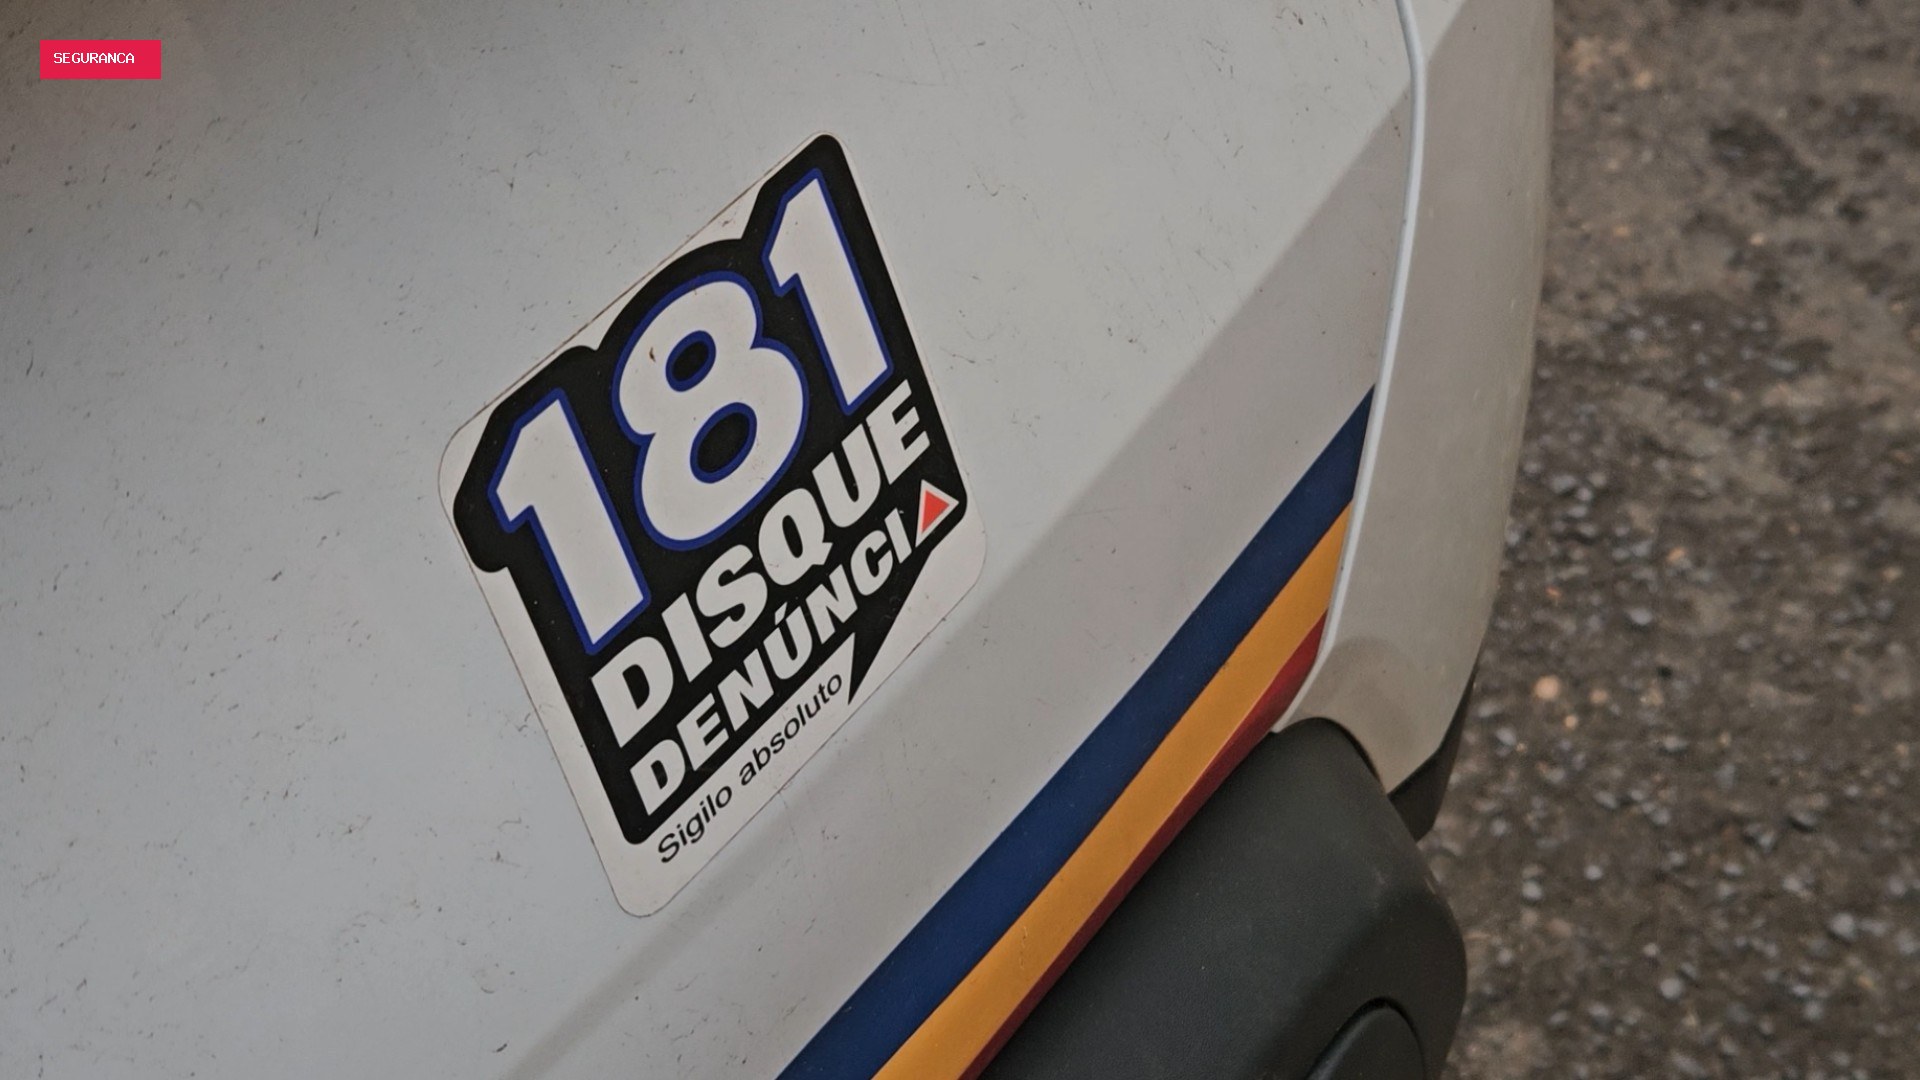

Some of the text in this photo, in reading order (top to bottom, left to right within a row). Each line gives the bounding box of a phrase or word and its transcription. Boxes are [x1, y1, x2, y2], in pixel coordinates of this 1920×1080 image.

[488, 168, 893, 653] 181
[591, 379, 931, 748] DISQUE
[657, 674, 843, 863] Sigilo absoluto
